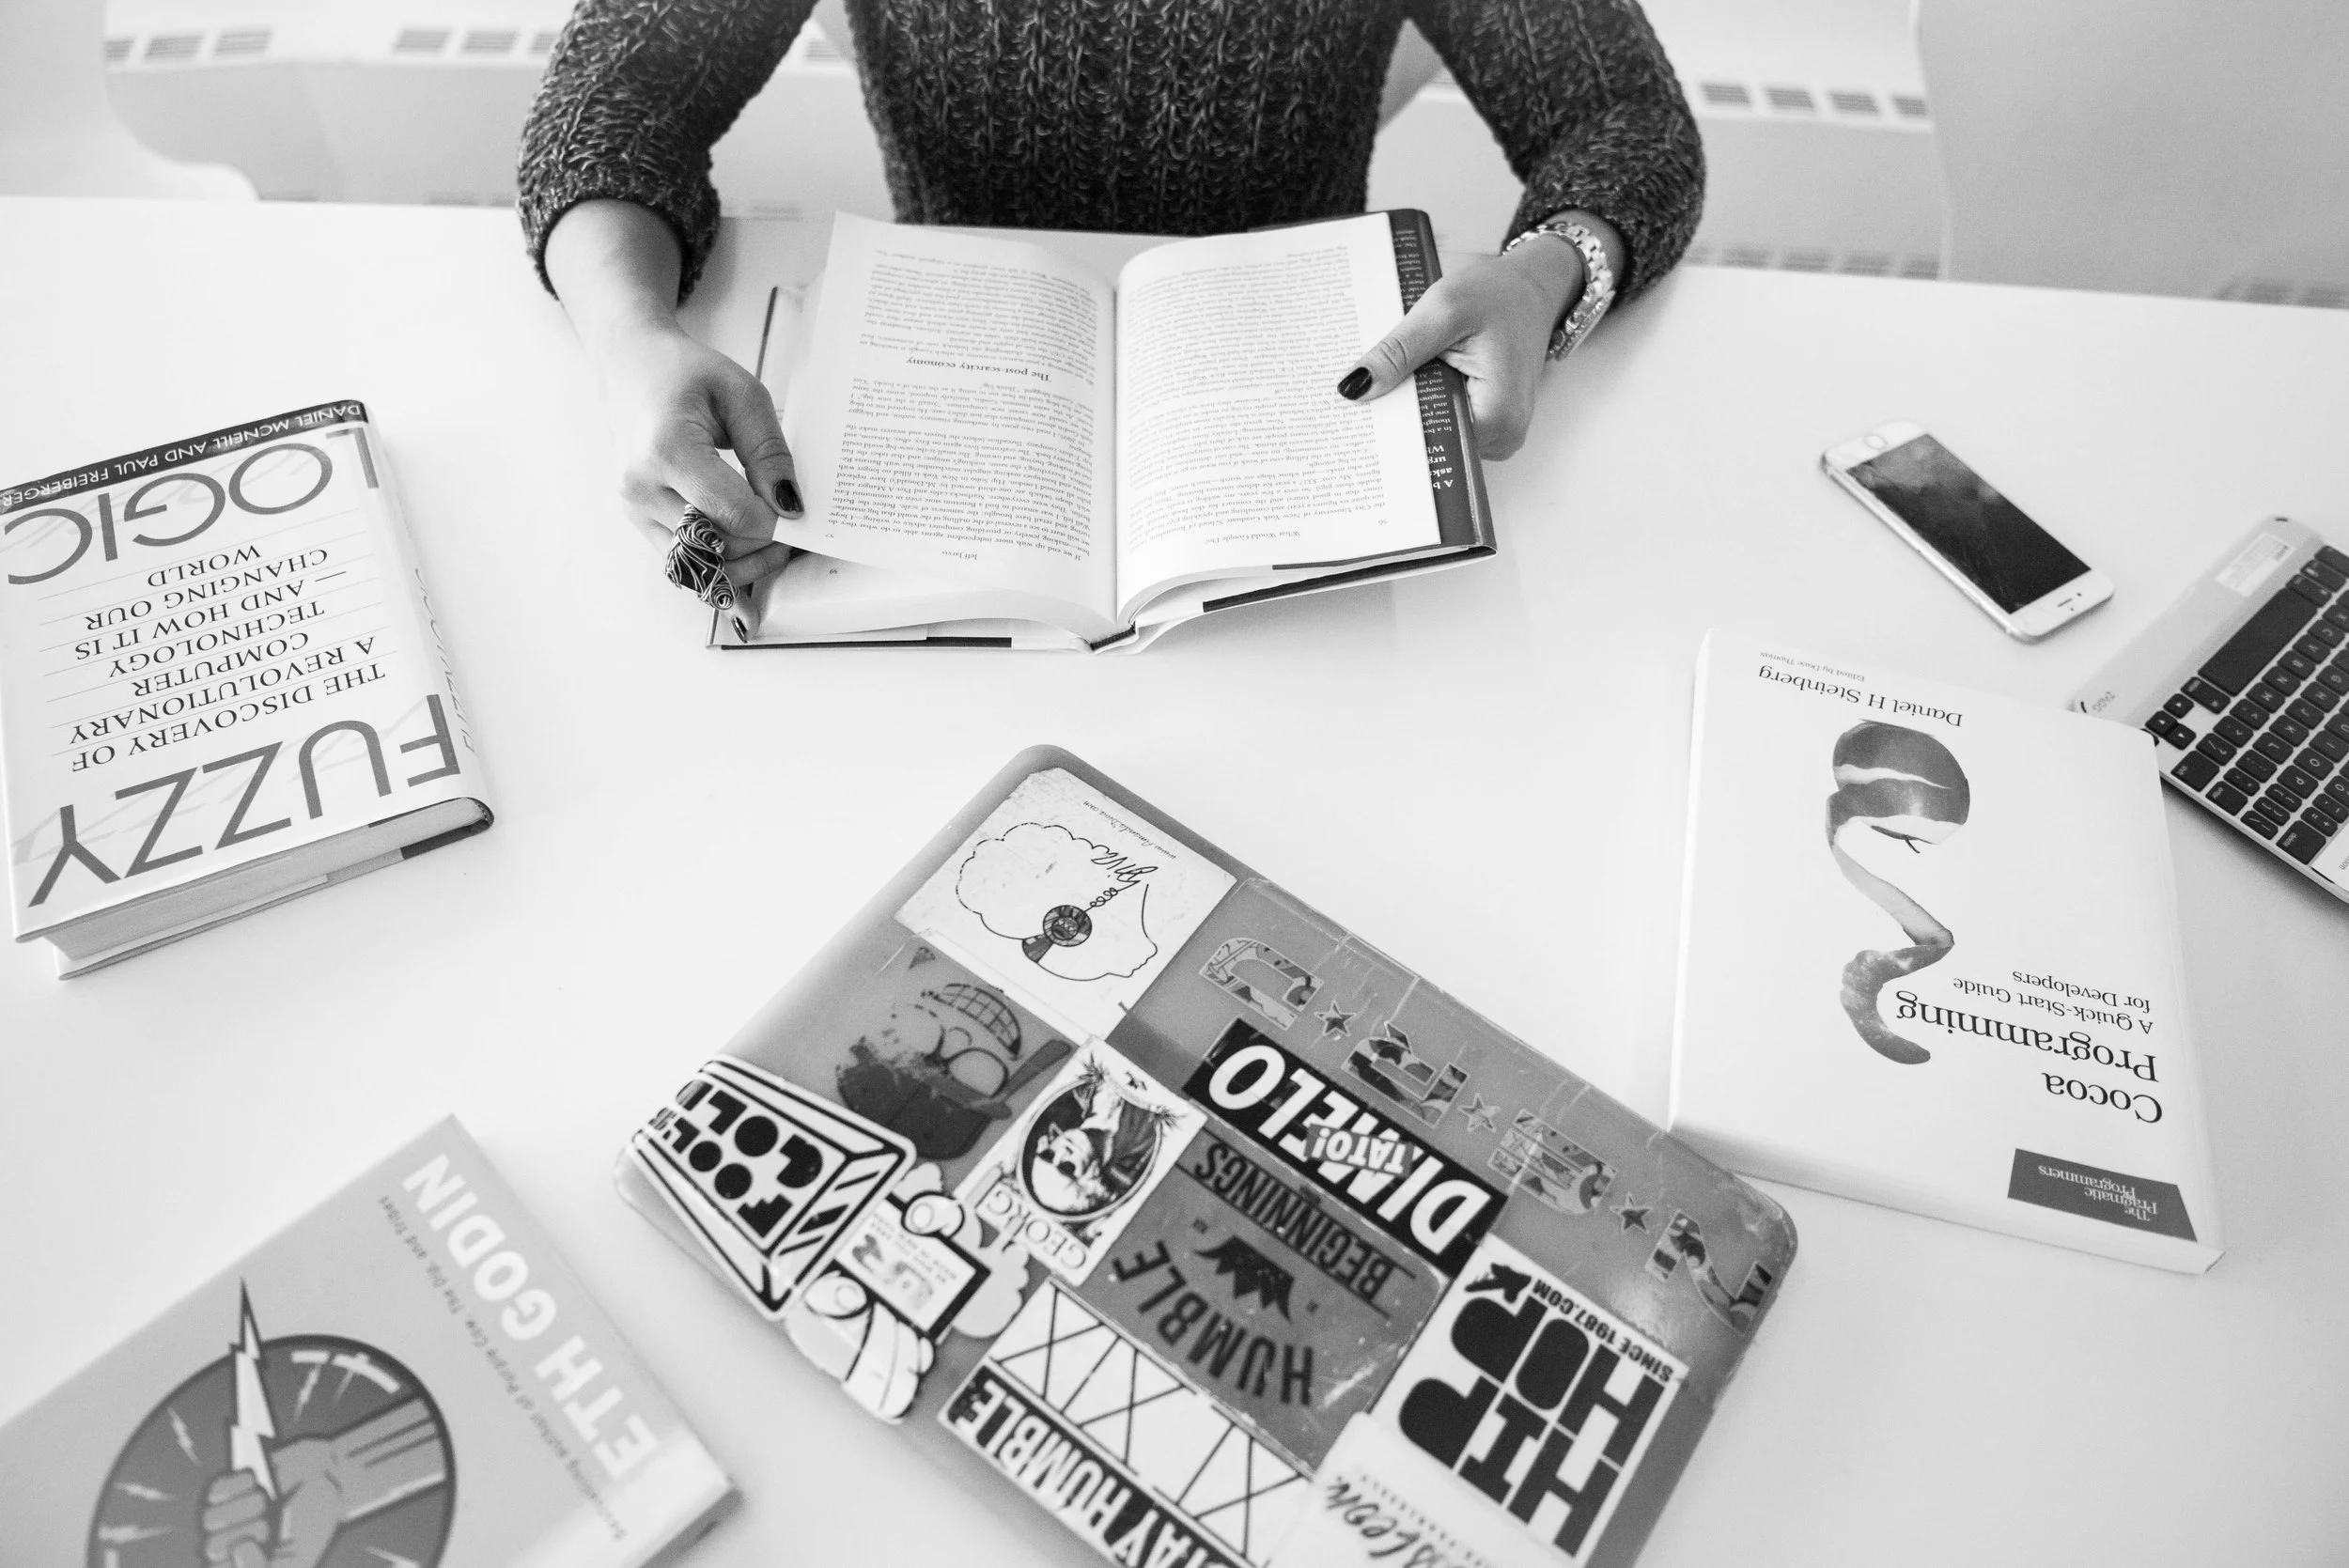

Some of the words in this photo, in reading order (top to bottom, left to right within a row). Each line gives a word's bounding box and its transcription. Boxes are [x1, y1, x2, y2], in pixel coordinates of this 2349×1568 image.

[908, 357, 957, 368] economy
[1032, 372, 1049, 381] The
[294, 405, 360, 427] DANIEL
[164, 442, 207, 462] AND
[212, 419, 289, 451] MCNEILL
[115, 455, 158, 475] PAUL
[0, 468, 109, 509] FREIBERGER
[1442, 479, 1454, 488] A
[0, 427, 380, 585] LOGIC
[148, 545, 261, 586] WORLD
[941, 551, 962, 559] Jarvis
[163, 550, 327, 609] CHANGING
[241, 580, 303, 611] AND
[85, 600, 152, 630] OUR
[152, 603, 229, 639] HOW
[75, 639, 101, 660] IS
[109, 601, 325, 677] TECHNOLOGY
[113, 629, 139, 650] IT
[354, 637, 374, 655] A
[132, 633, 308, 697] COMPUTER
[1760, 652, 1795, 665] Thomas
[1797, 661, 1820, 672] Dave
[1823, 665, 1834, 675] by
[1836, 670, 1865, 682] Edited
[70, 646, 344, 744] REVOLUTIONARY
[323, 663, 385, 695] THE
[1759, 665, 1860, 703] Steinberg
[1868, 693, 1885, 709] H
[1893, 699, 1962, 727] Daniel
[130, 686, 314, 755] DISCOVERY
[72, 746, 115, 772] OF
[27, 693, 461, 908] FUZZY
[1953, 979, 2011, 1003] Guide
[2013, 971, 2118, 1007] Developers
[2123, 996, 2150, 1014] for
[2019, 993, 2133, 1031] Quick-Start
[2139, 1019, 2154, 1034] A
[1896, 990, 2159, 1082] Programming
[2042, 1073, 2163, 1124] Cocoa
[682, 1082, 823, 1189] GOLD
[1208, 1045, 1490, 1254] DIMELO
[1312, 1124, 1408, 1174] TATO!
[644, 1102, 795, 1239] FOOL'S
[2037, 1163, 2136, 1198] Programmers
[2082, 1184, 2157, 1214] Pragmatic
[2123, 1205, 2151, 1221] The
[973, 1177, 1090, 1274] GEORG
[1188, 1135, 1397, 1303] BEGINNINGS
[402, 1154, 556, 1340] GODIN
[1110, 1239, 1310, 1405] HUMBLE
[1532, 1280, 1616, 1344] 1987.COM
[1619, 1338, 1673, 1382] SINCE
[1451, 1295, 1665, 1467] HOP
[535, 1335, 666, 1484] ETH
[954, 1372, 1136, 1544] HUMBLE
[1398, 1375, 1620, 1558] HIP
